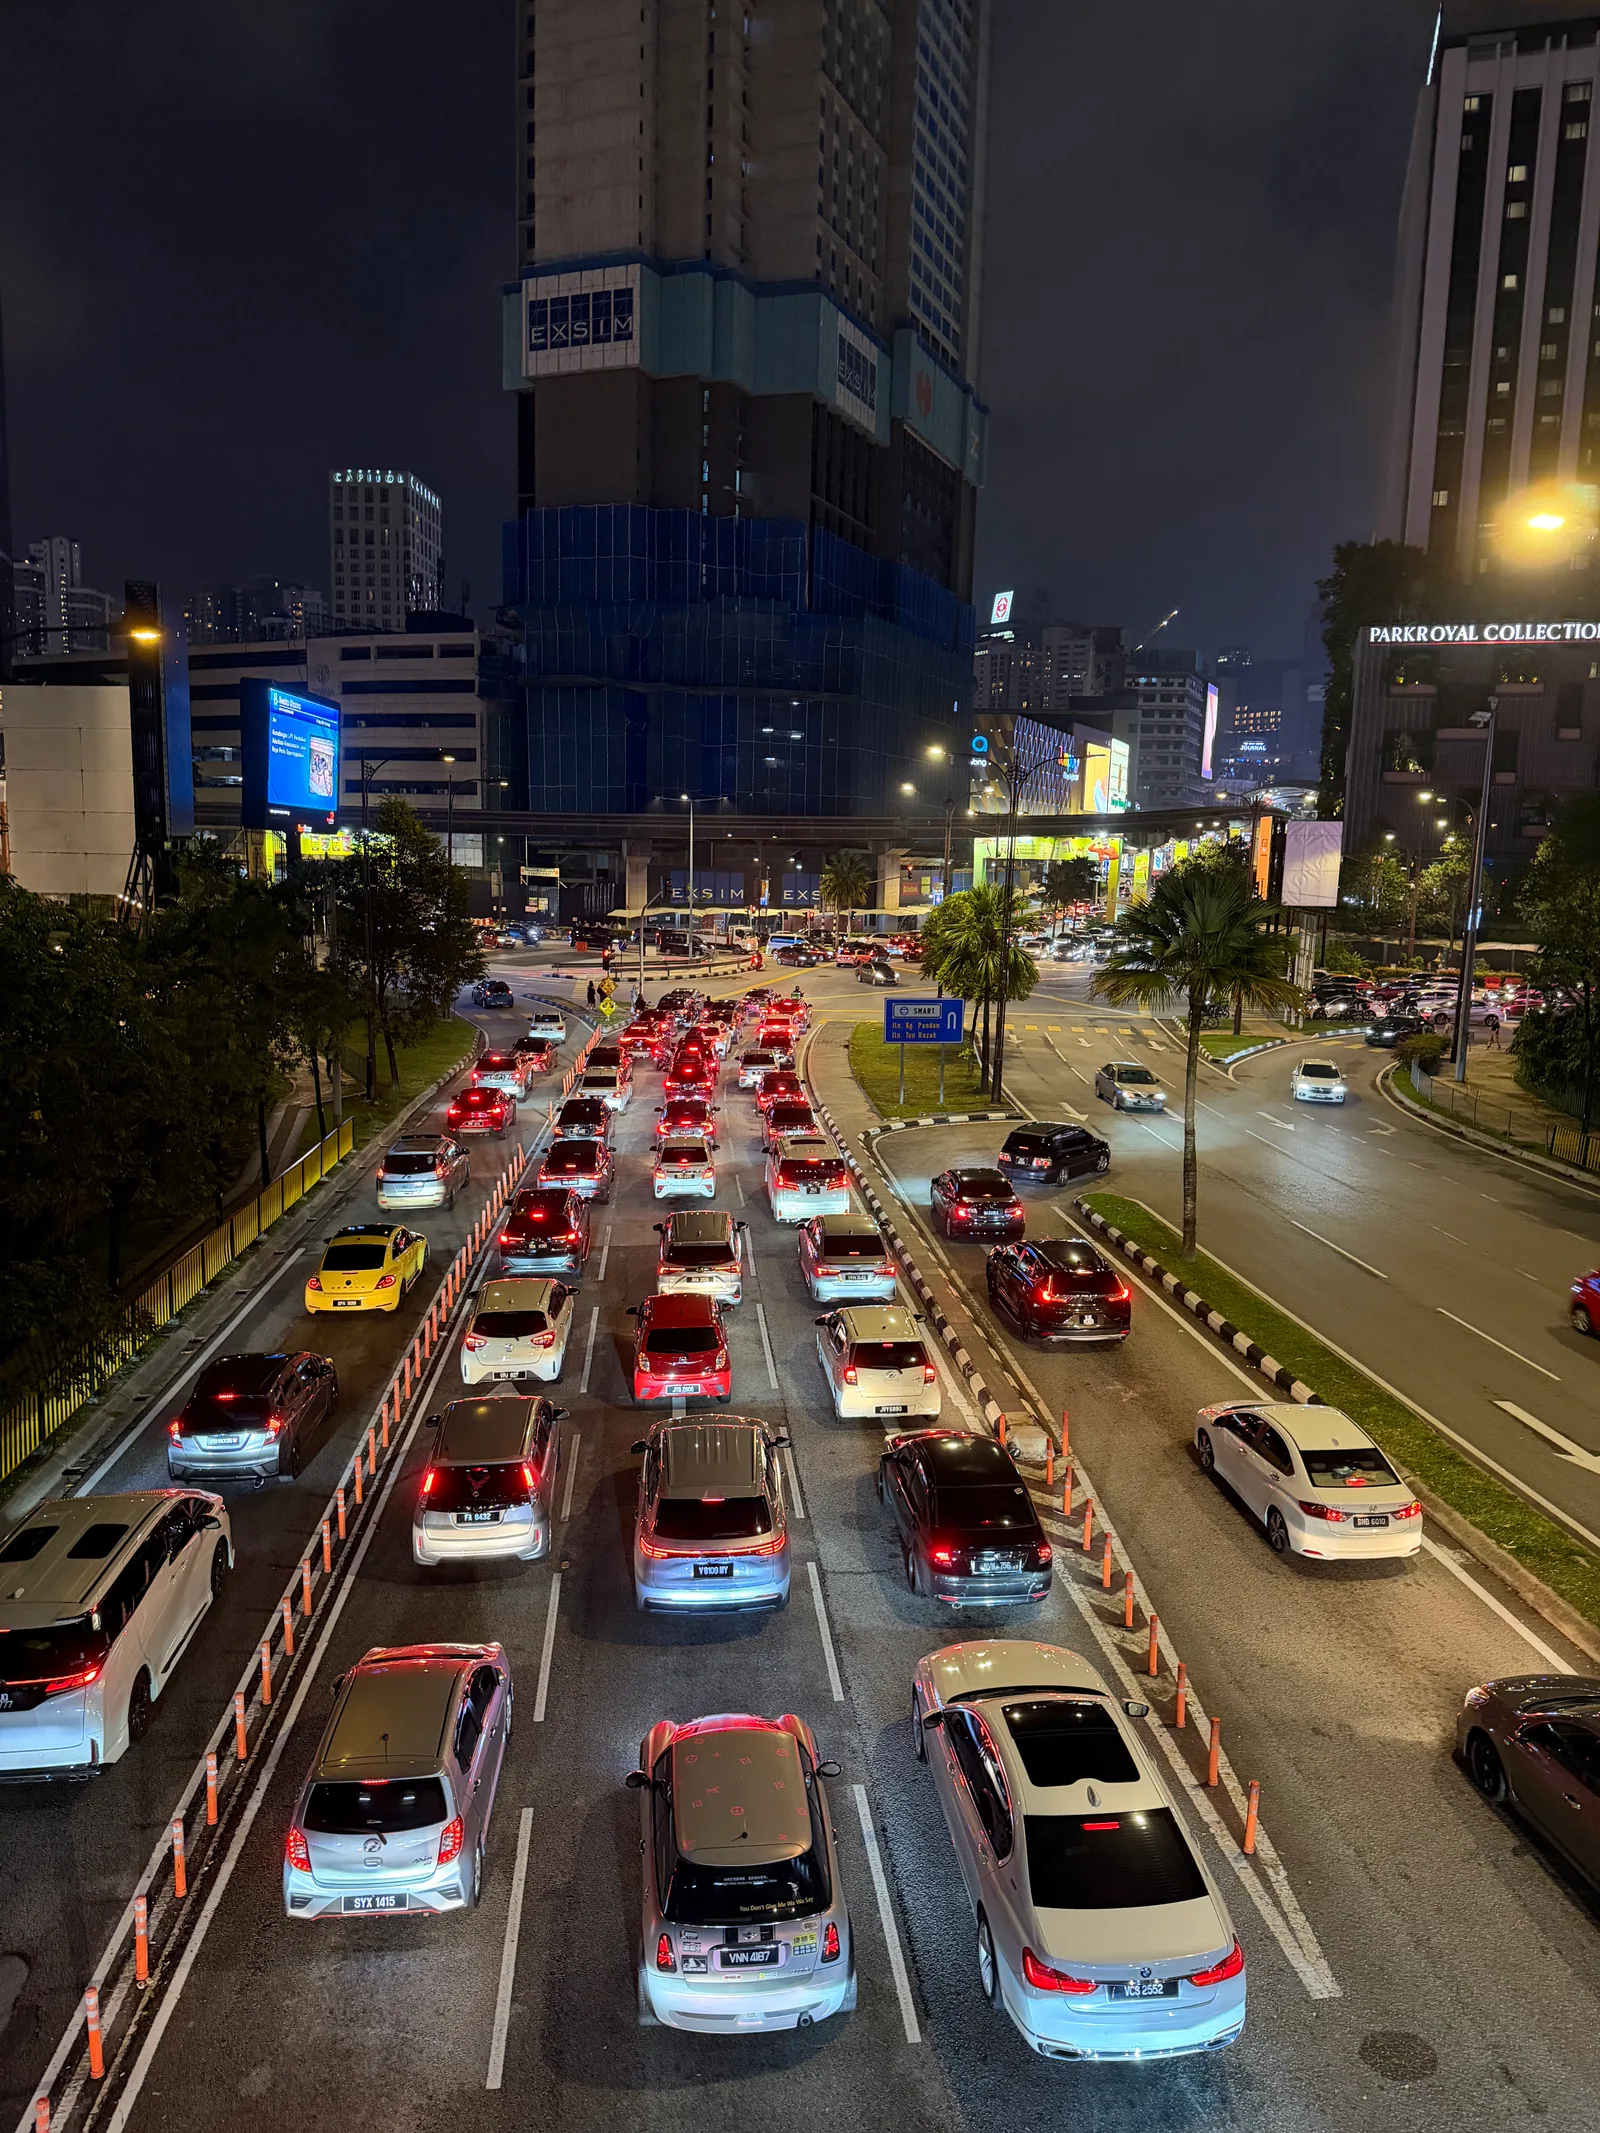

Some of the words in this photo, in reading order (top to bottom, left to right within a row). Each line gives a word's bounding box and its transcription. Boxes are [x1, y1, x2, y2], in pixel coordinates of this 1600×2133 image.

[531, 316, 632, 343] EXSIM
[838, 362, 876, 401] EXSIM
[1370, 625, 1478, 642] PARKROYAL
[672, 888, 744, 900] EXSIM
[914, 1007, 935, 1015] SMART
[905, 1022, 914, 1030] Kg.
[354, 1897, 373, 1909] SYX
[376, 1895, 396, 1908] 1415
[729, 1953, 749, 1963] VNN
[750, 1951, 770, 1962] 4187
[1142, 1983, 1164, 1996] 2552
